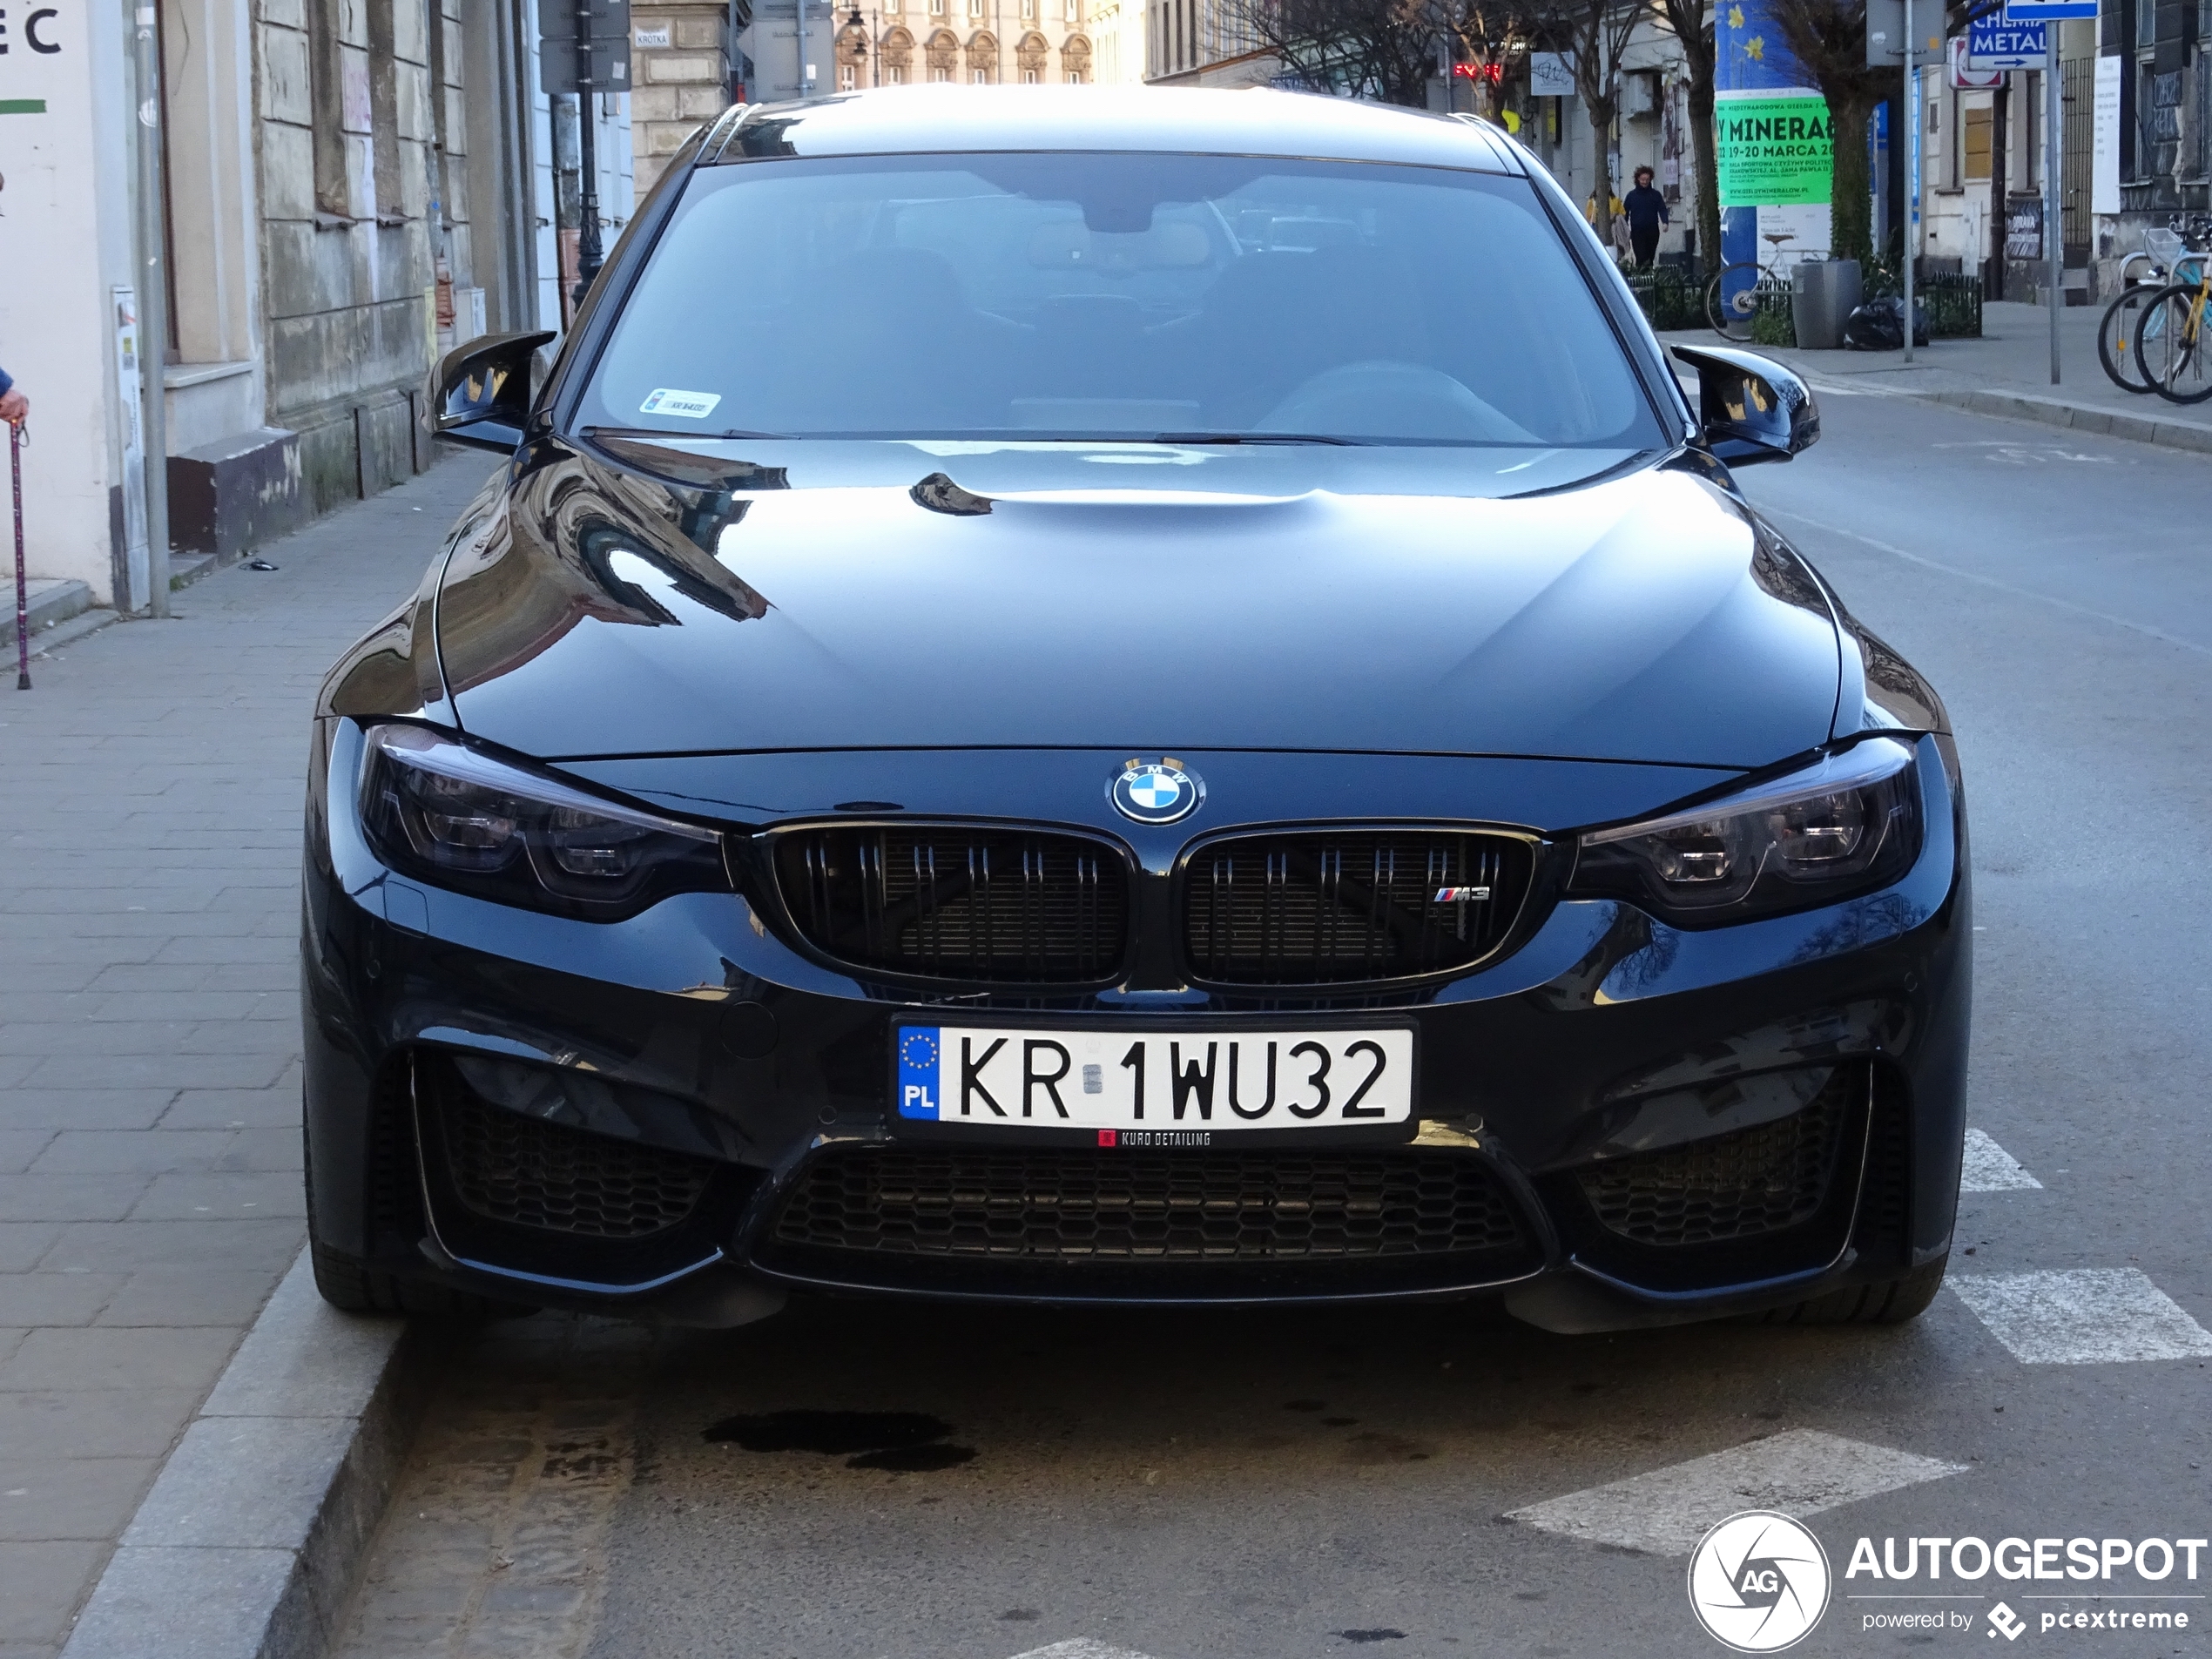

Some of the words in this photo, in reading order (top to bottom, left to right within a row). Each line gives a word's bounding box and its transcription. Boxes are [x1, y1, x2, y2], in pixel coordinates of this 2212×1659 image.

[1730, 145, 1759, 158] 19-20
[1764, 144, 1817, 157] MARCA
[1123, 765, 1188, 783] BMW
[1449, 887, 1490, 901] M3
[961, 1036, 1071, 1119] KR
[1120, 1040, 1386, 1121] 1WU32
[904, 1085, 934, 1108] PL
[1122, 1132, 1151, 1146] KURO
[1155, 1132, 1211, 1146] DETAILING
